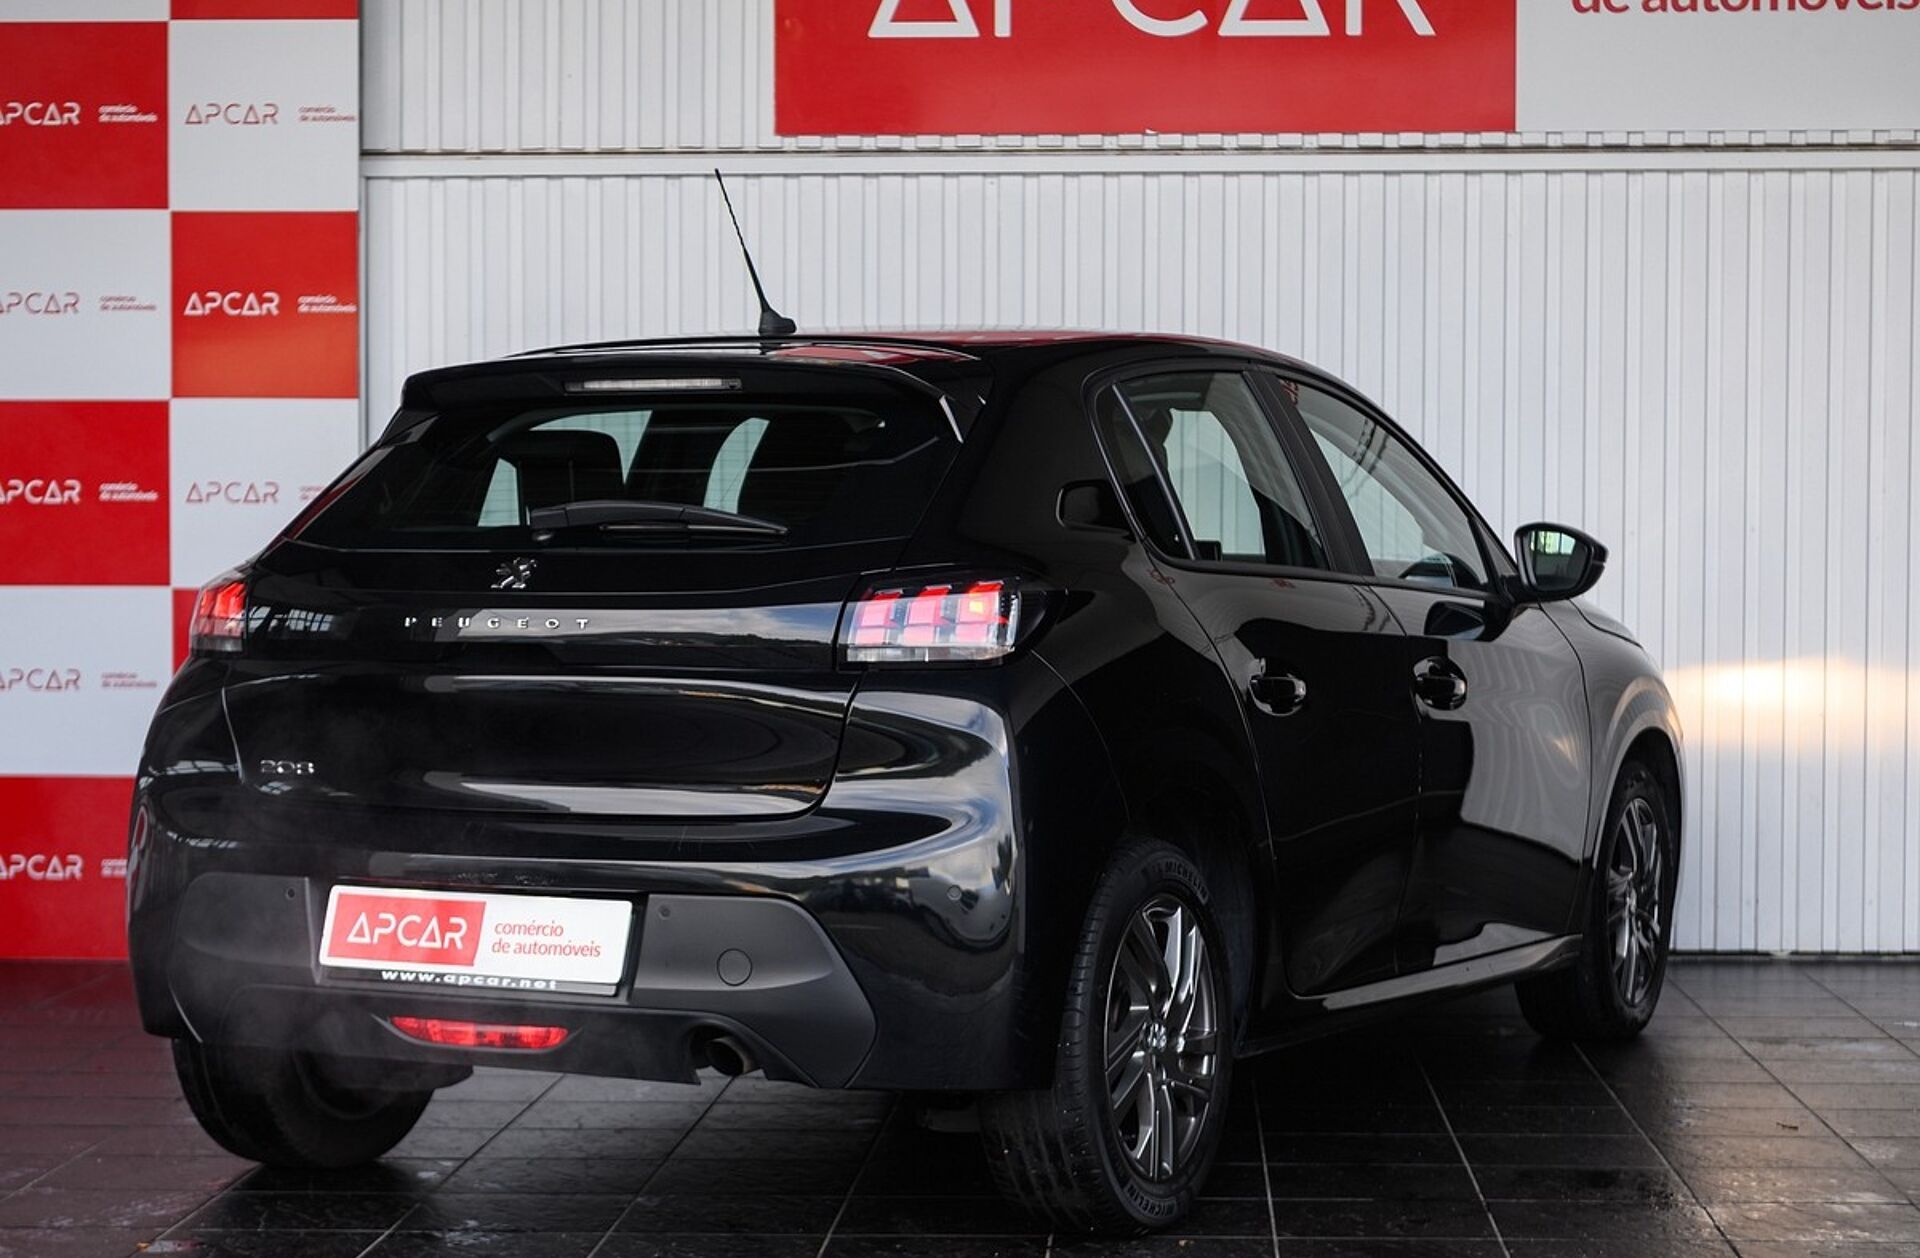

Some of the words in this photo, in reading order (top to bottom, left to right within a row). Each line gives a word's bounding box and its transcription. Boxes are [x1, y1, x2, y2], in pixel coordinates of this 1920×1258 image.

[185, 103, 278, 125] APCAR
[184, 292, 279, 316] APCAR
[186, 482, 279, 504] APCAR
[404, 615, 590, 630] PEUGEOT
[346, 911, 468, 950] APCAR
[494, 920, 564, 938] comércio
[491, 938, 511, 954] de
[513, 940, 602, 958] automóveis
